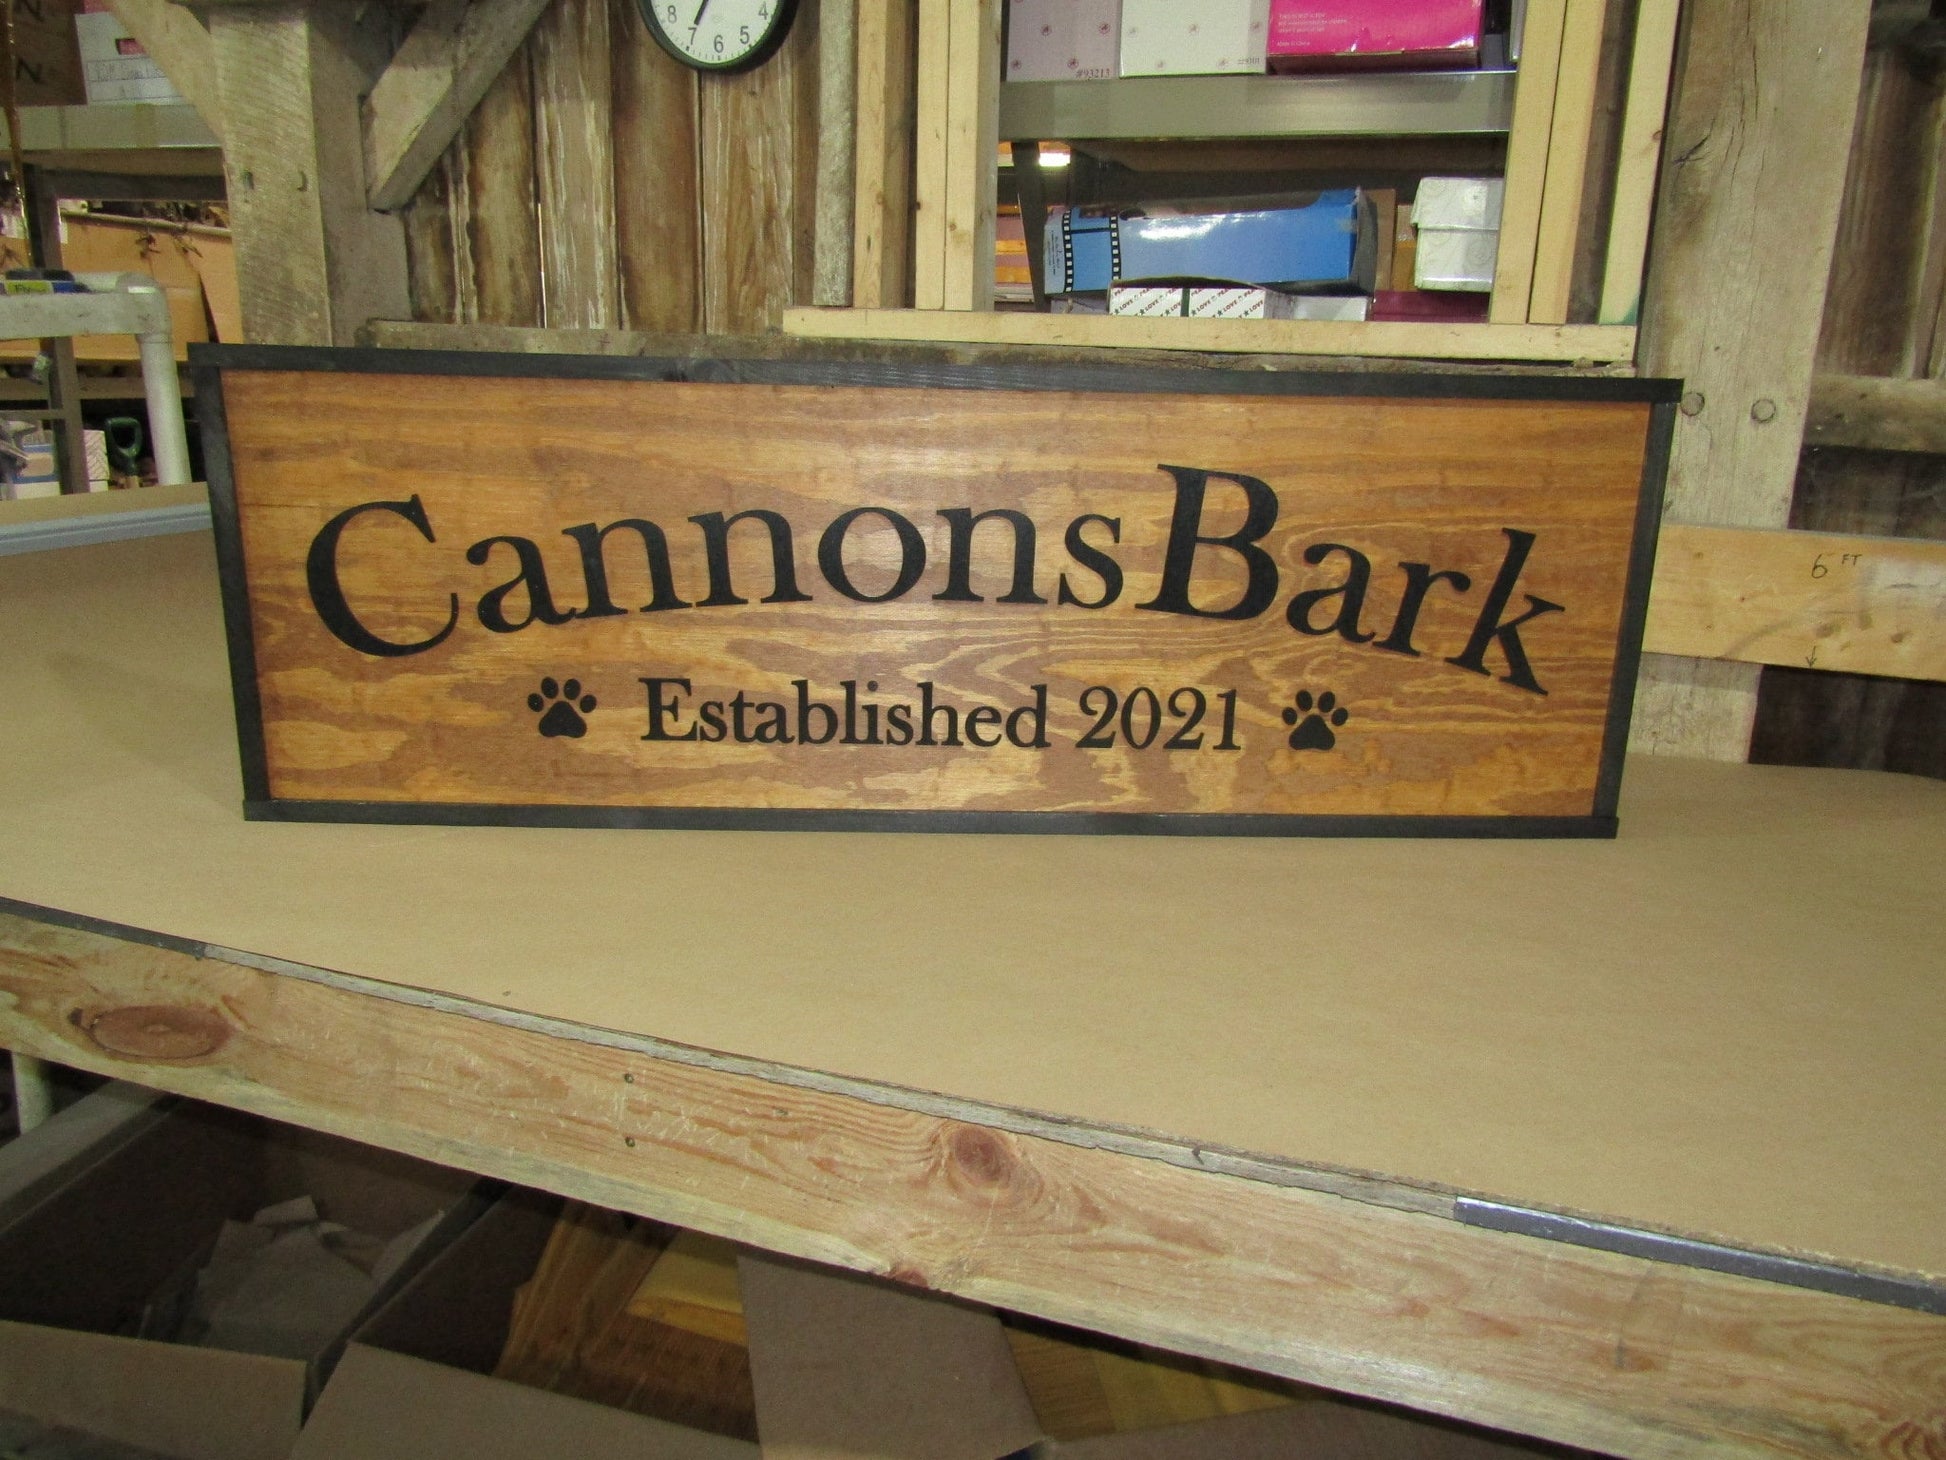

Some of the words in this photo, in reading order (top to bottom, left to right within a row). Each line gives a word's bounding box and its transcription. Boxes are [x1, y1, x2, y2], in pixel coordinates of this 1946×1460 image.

[667, 5, 677, 24] 8
[758, 1, 768, 20] 4
[688, 27, 697, 45] 7
[713, 35, 724, 53] 6
[740, 26, 750, 45] 5
[1811, 553, 1828, 579] 6
[1842, 553, 1862, 566] FT
[305, 464, 1566, 698] CannonsBark
[638, 677, 1052, 752] Established
[1075, 686, 1242, 751] 2021
